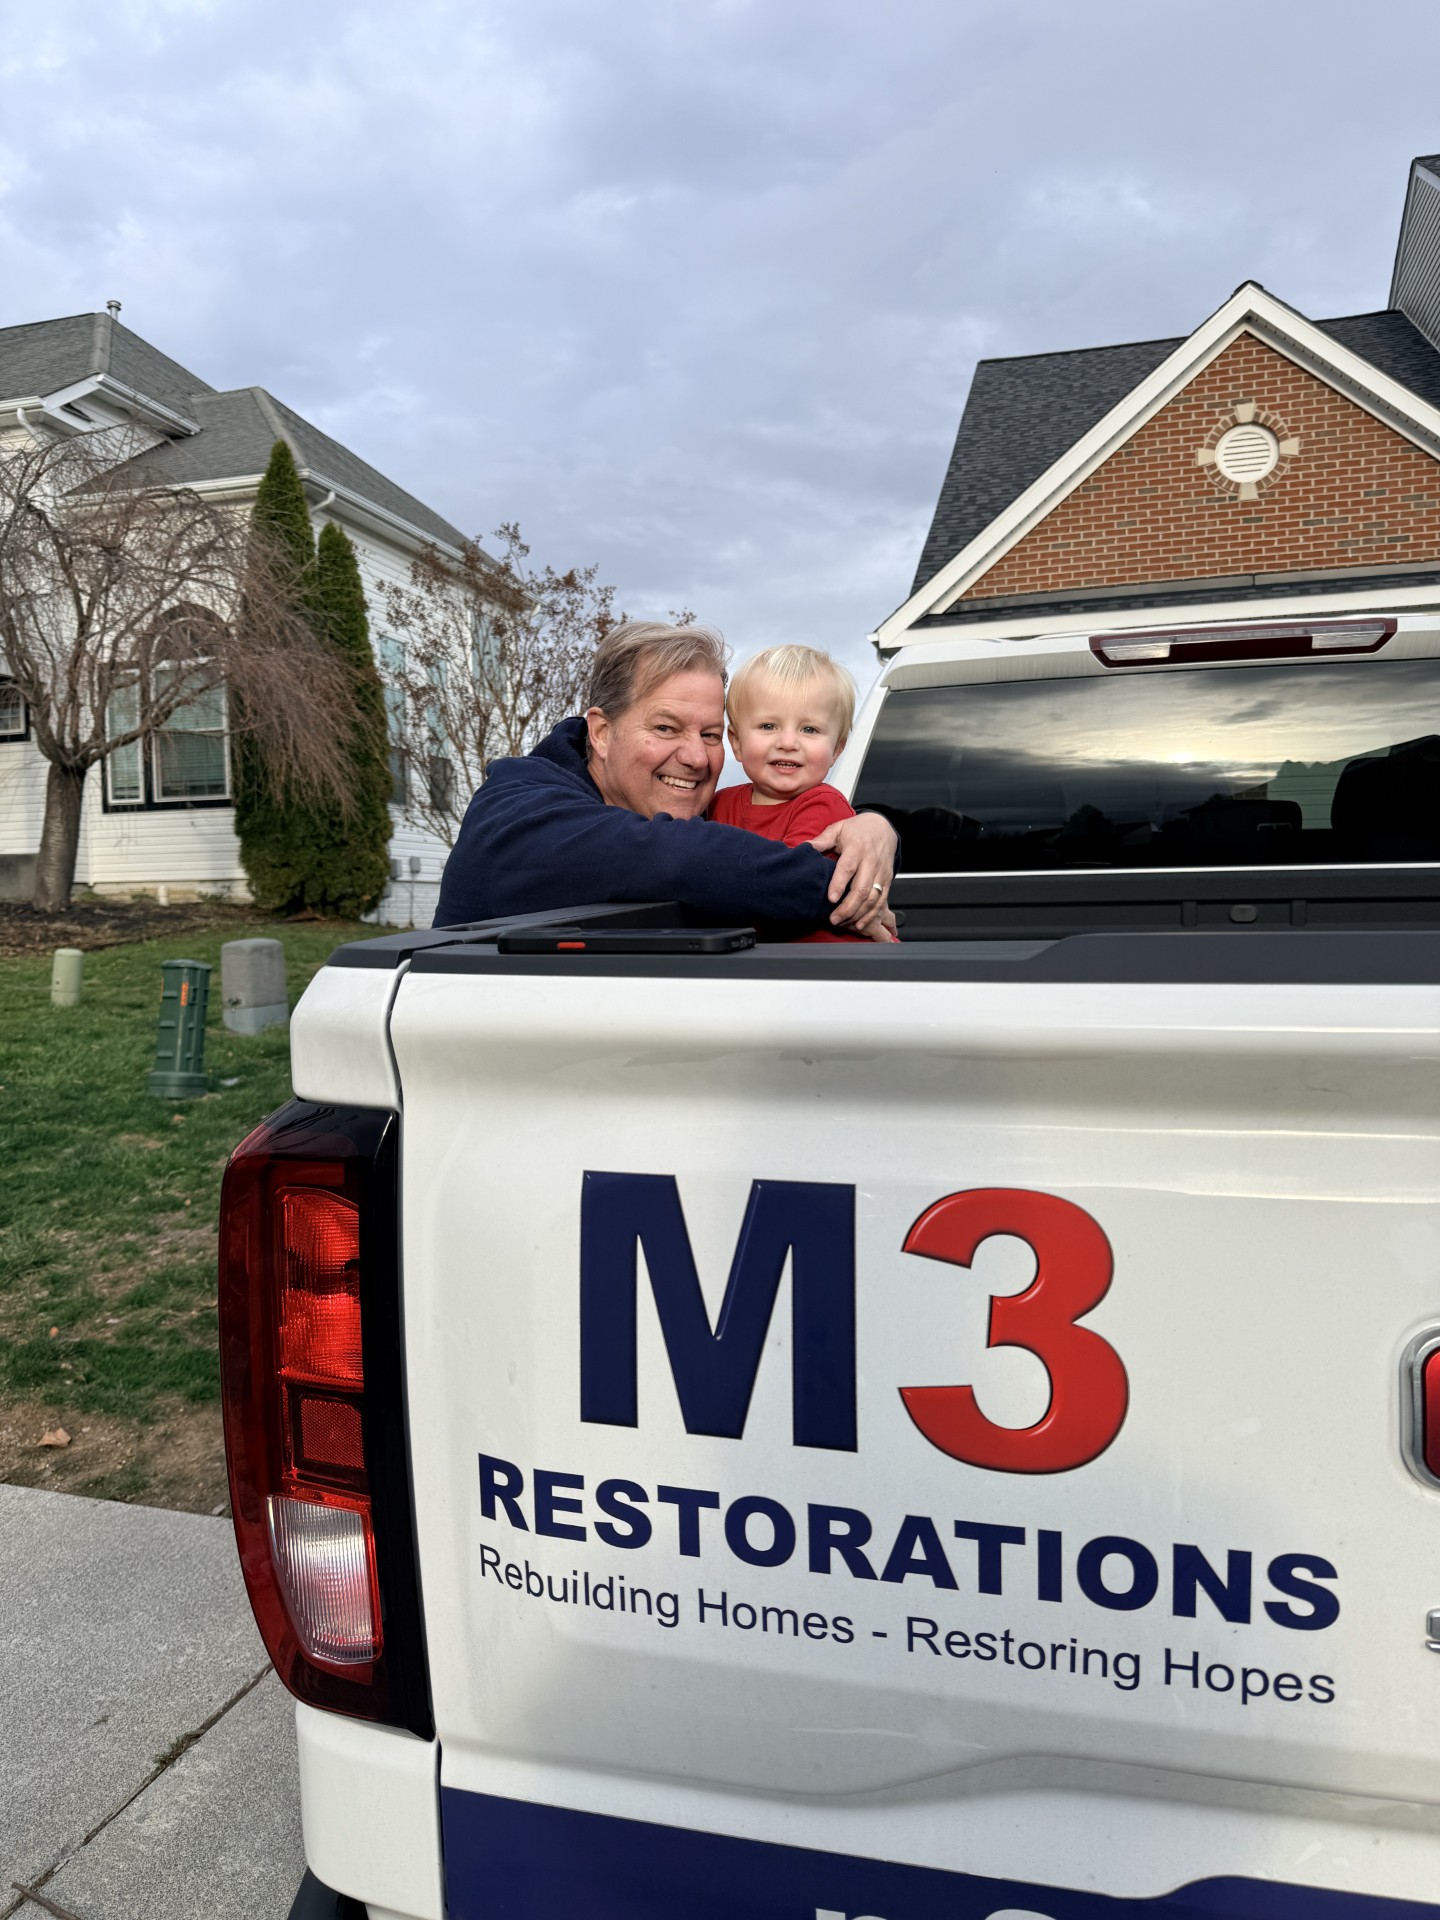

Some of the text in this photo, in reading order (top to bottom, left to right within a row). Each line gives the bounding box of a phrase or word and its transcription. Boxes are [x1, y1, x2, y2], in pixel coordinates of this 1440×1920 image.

[579, 1170, 1131, 1476] M3
[478, 1452, 1341, 1631] RESTORATIONS
[479, 1543, 681, 1628] Rebuilding
[698, 1588, 856, 1644] Homes
[906, 1616, 1142, 1691] Restoring
[1164, 1647, 1336, 1706] Hopes
